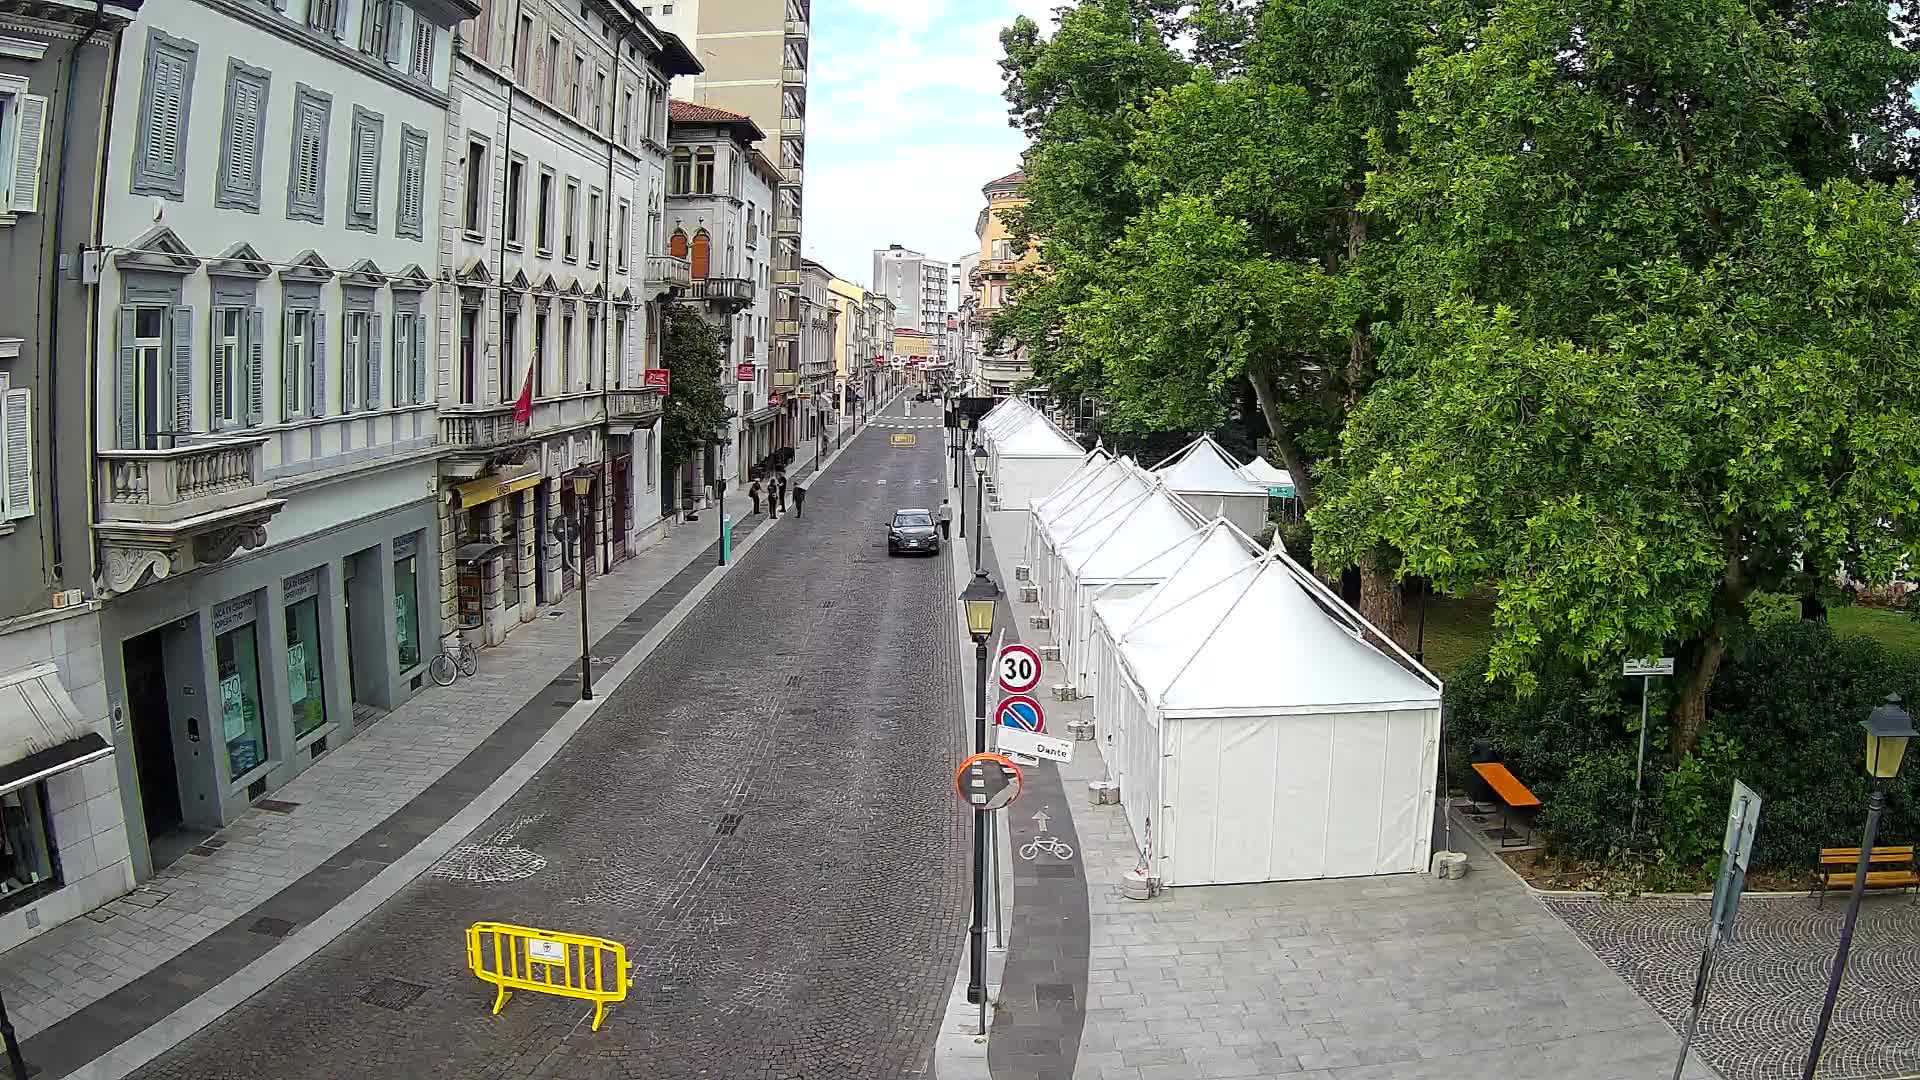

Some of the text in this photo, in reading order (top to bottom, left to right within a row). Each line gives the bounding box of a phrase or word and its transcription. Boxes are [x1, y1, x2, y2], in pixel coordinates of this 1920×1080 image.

[1005, 658, 1032, 680] 30
[221, 678, 240, 701] 130
[1037, 744, 1067, 758] Dante
